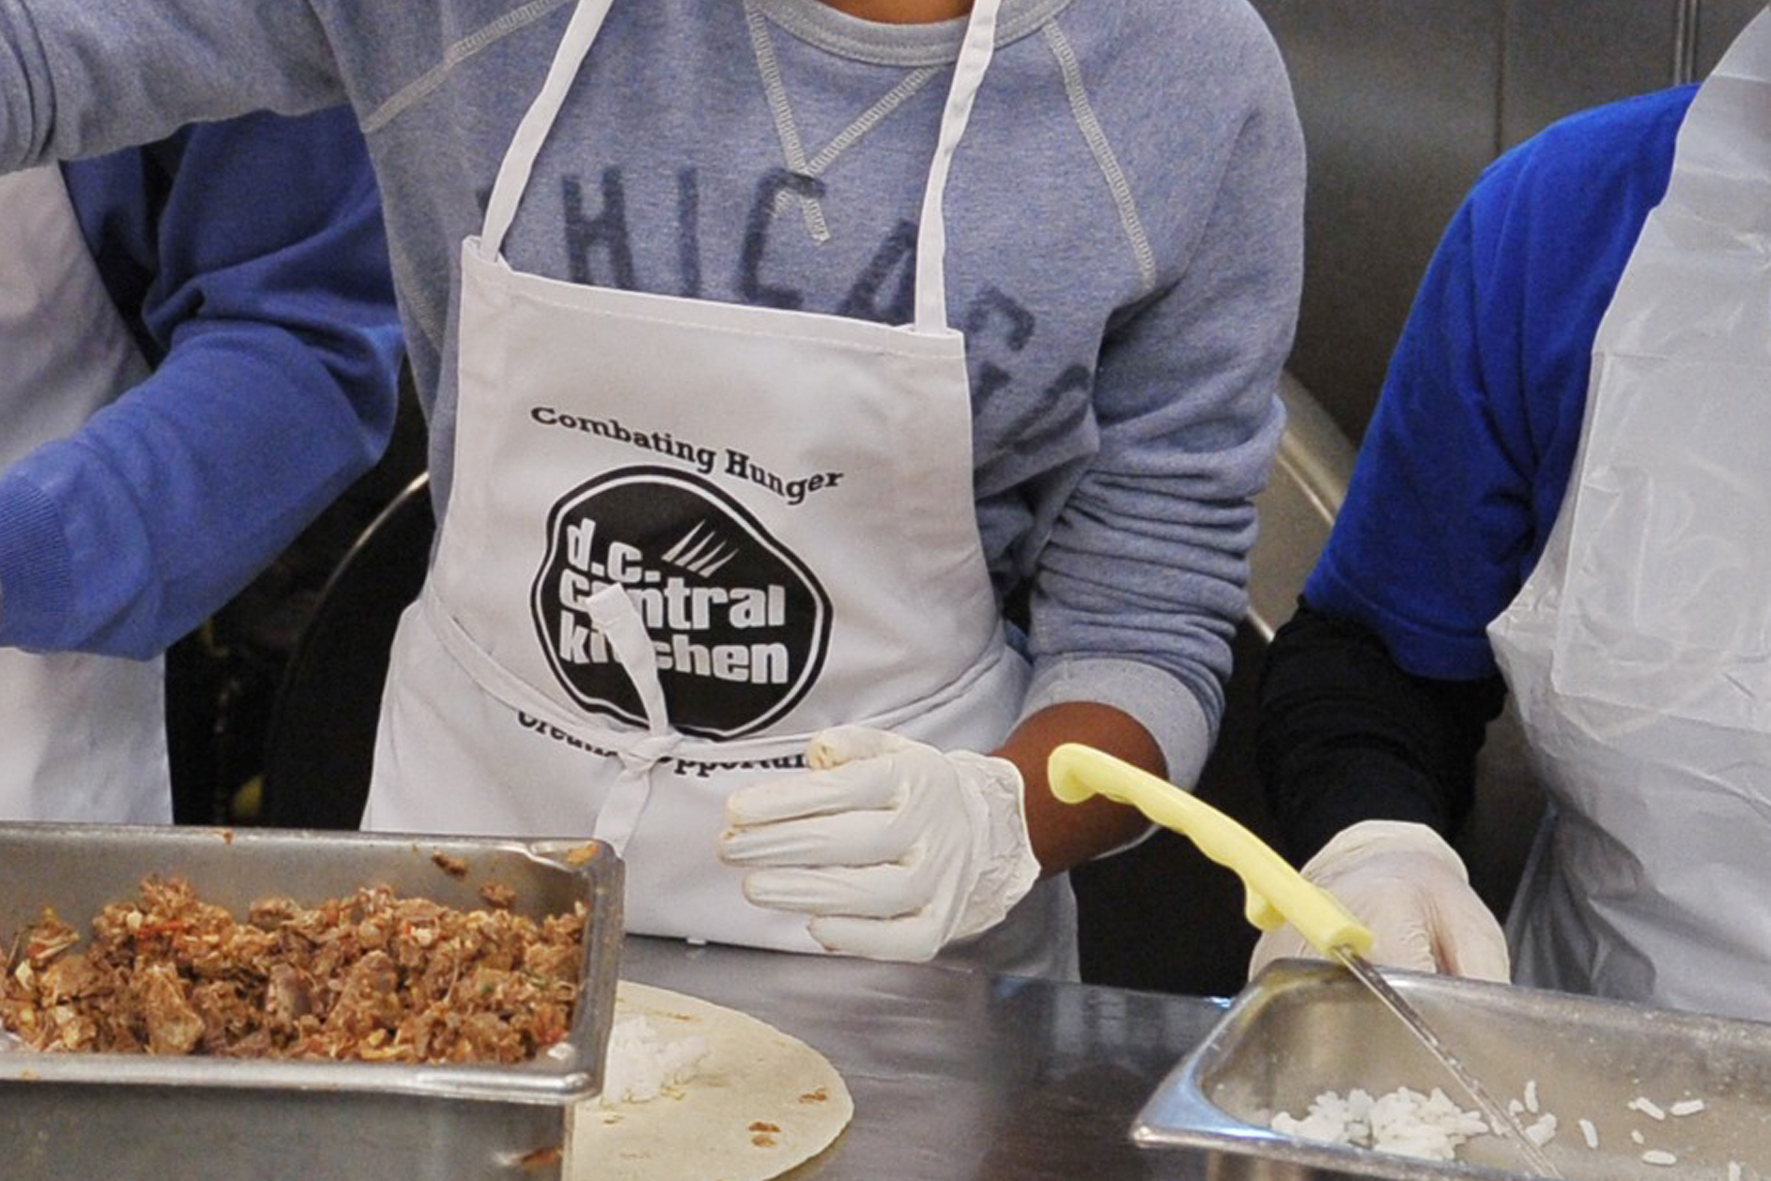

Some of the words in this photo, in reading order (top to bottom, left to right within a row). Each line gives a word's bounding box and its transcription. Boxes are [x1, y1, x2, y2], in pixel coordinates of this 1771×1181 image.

[530, 406, 716, 475] Combating
[724, 448, 845, 506] Hunger
[566, 517, 662, 584] d.c.
[559, 568, 786, 631] cntral
